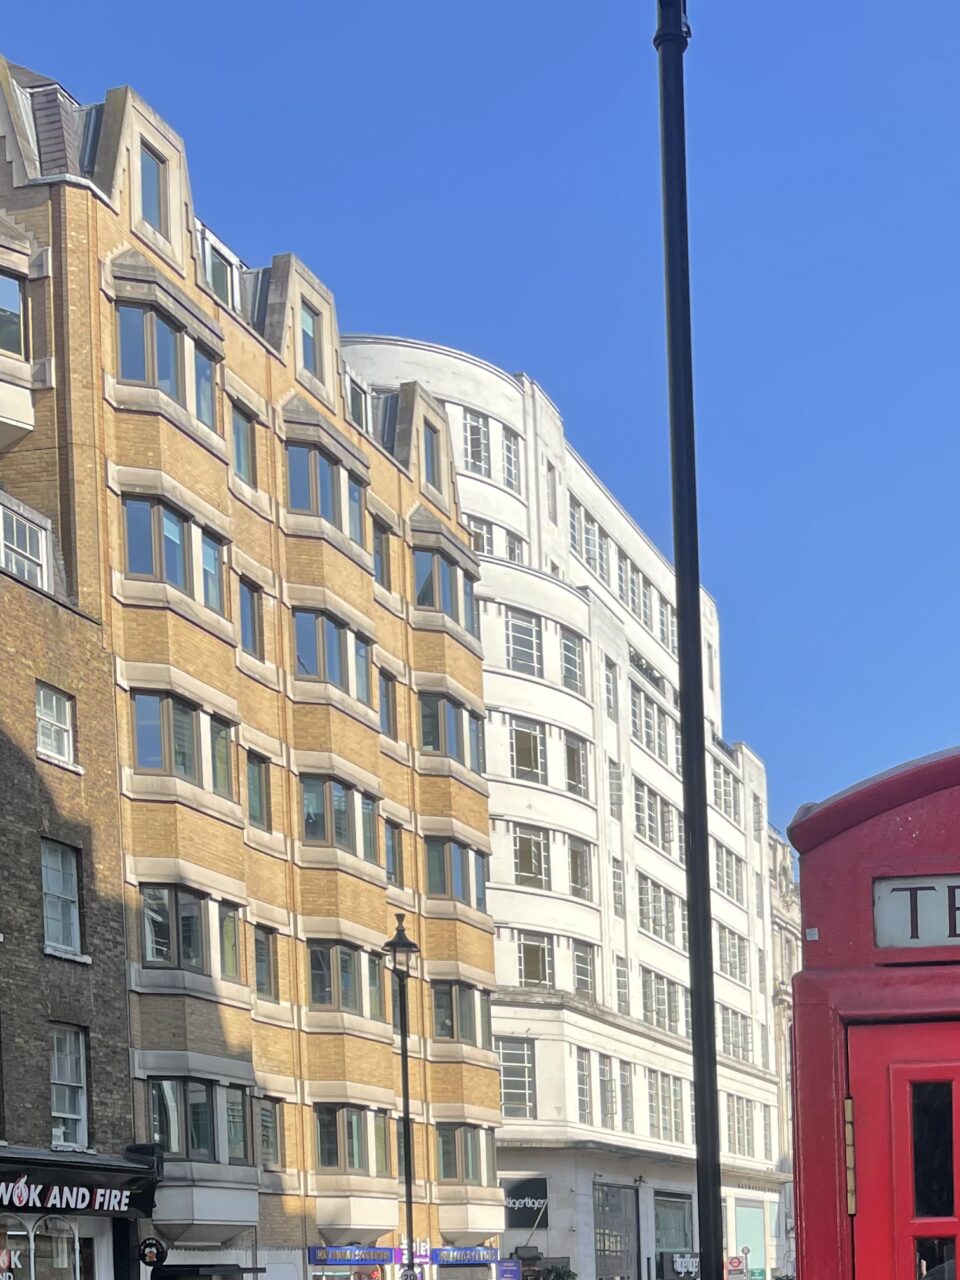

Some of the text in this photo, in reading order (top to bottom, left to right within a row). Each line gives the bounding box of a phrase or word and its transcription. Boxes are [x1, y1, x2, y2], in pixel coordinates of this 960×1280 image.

[0, 1174, 131, 1211] WOK AND FIRE
